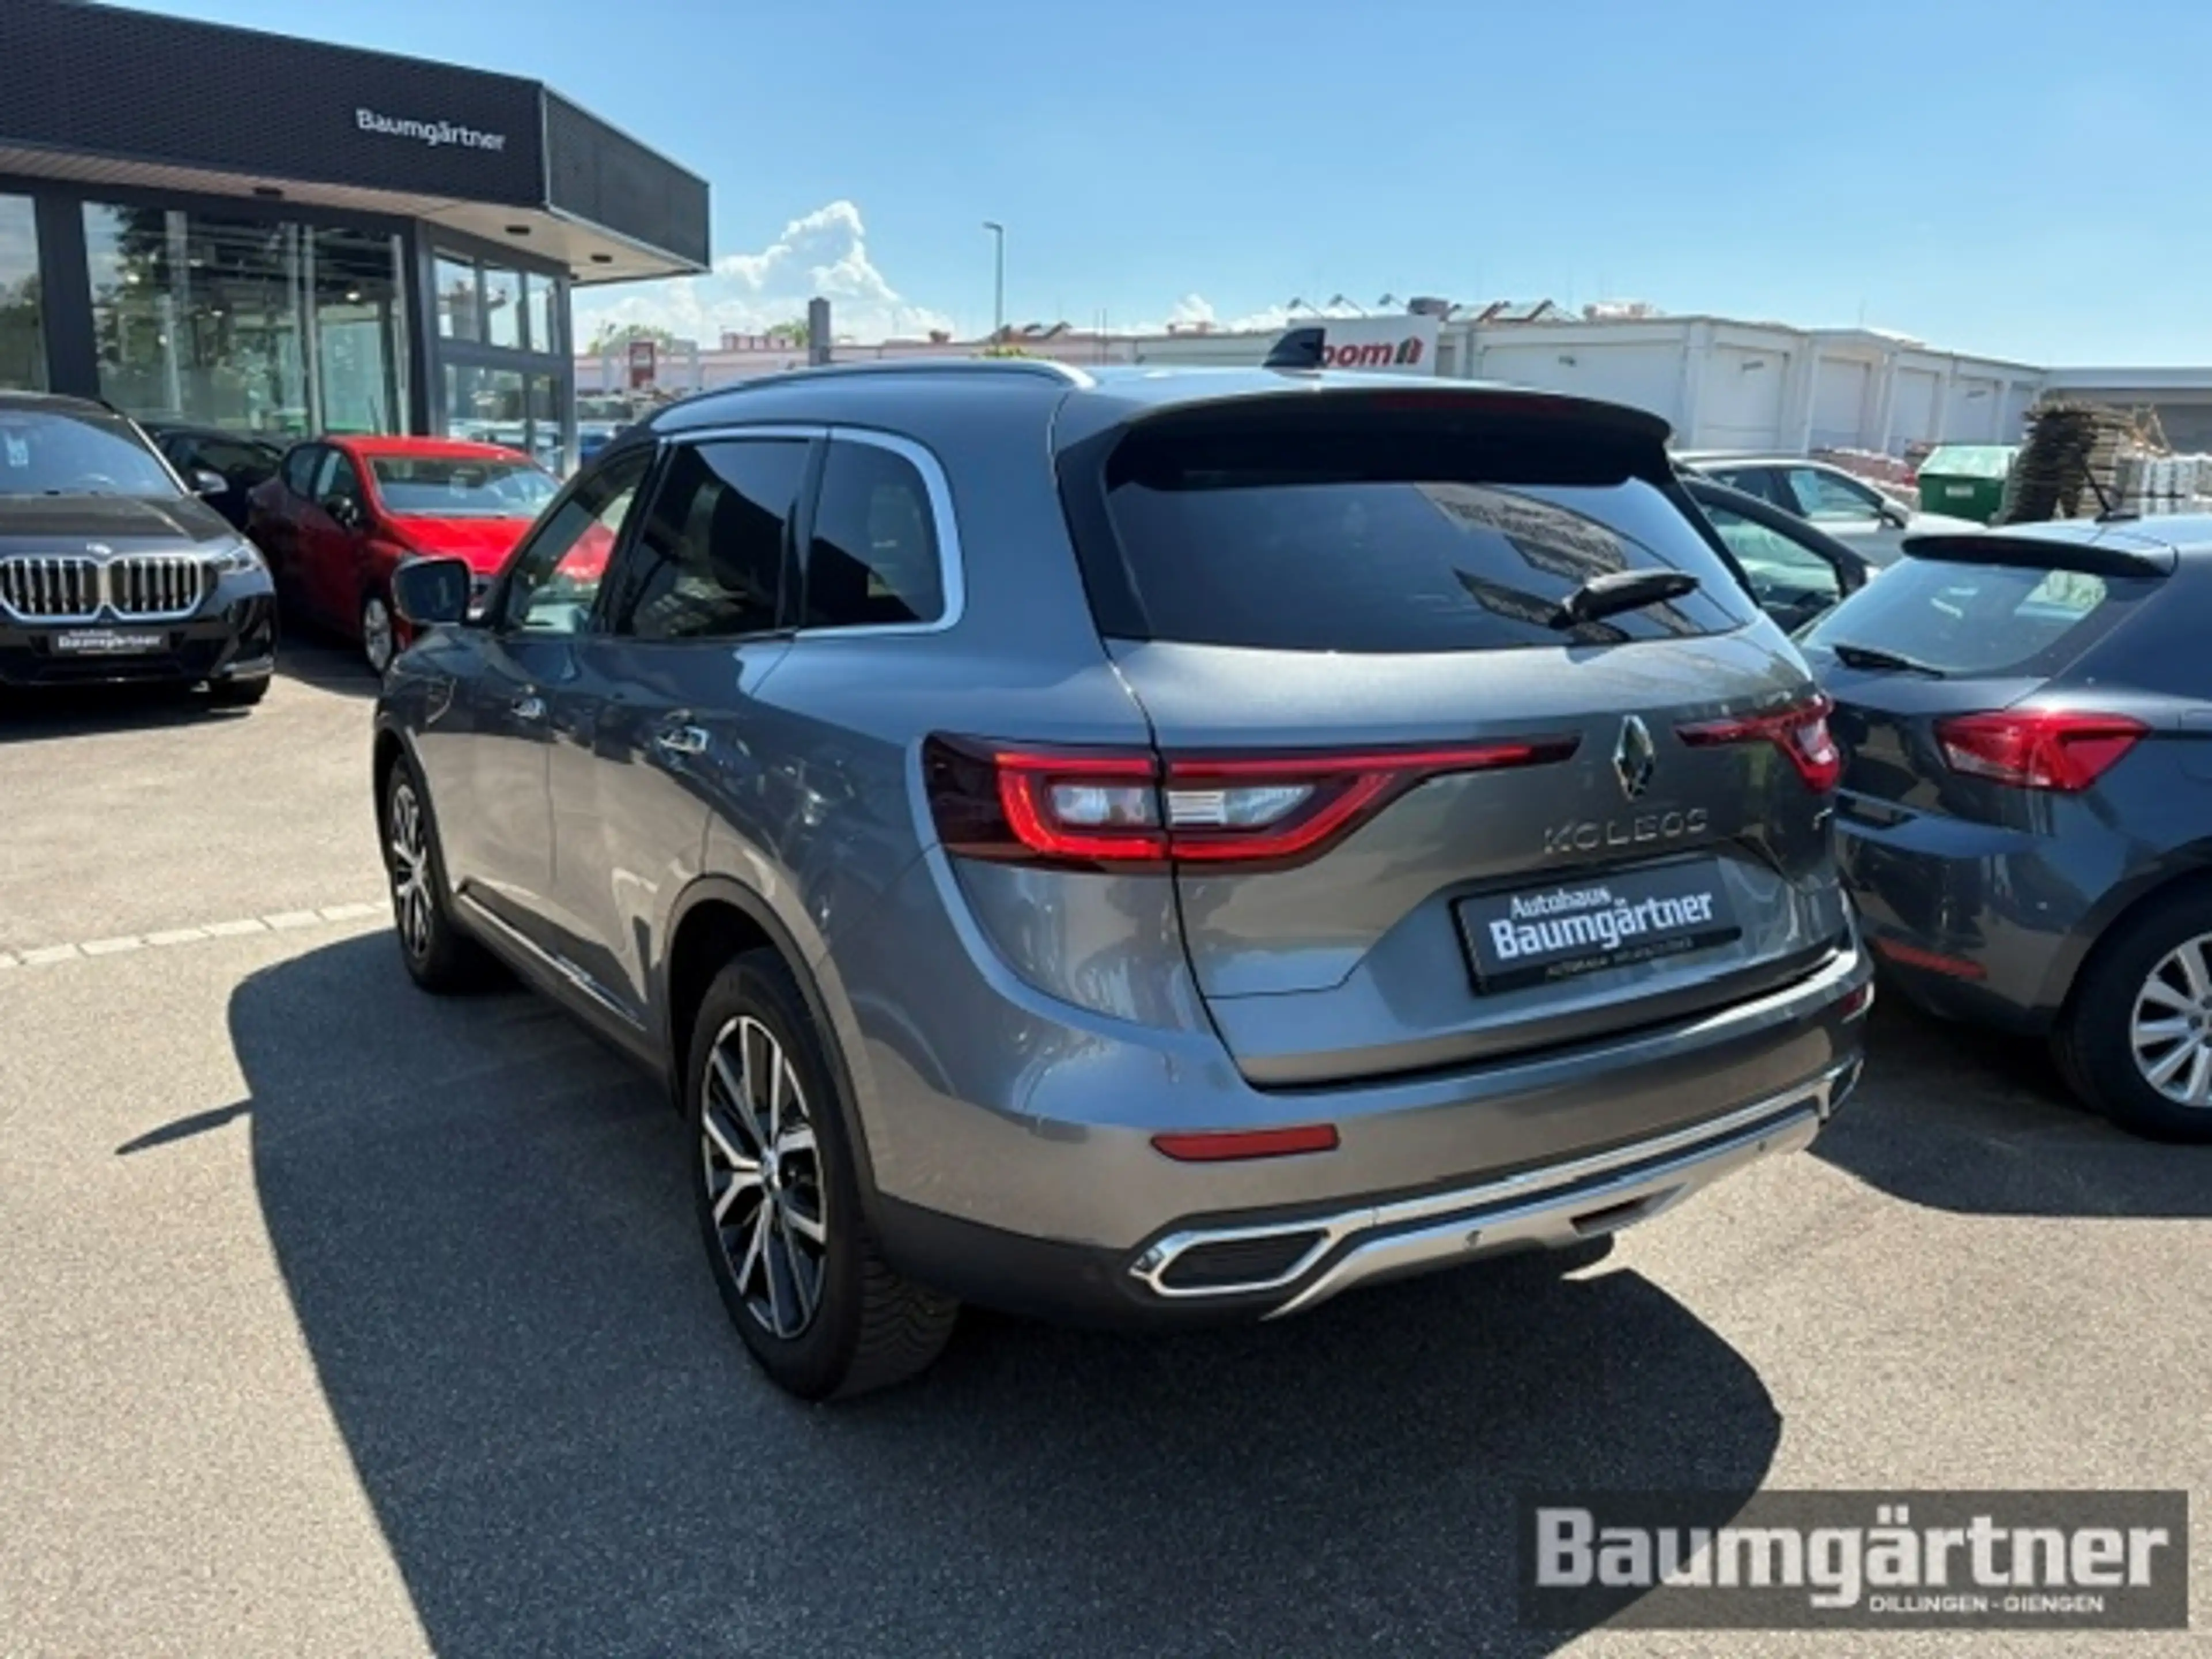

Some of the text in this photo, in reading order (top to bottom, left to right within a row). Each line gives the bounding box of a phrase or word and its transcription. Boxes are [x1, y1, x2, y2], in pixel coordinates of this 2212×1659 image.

[355, 108, 506, 151] Baumgärtner
[1324, 342, 1393, 366] oom
[1544, 807, 1709, 854] KOLEOS
[1511, 886, 1611, 919] Autohaus
[1489, 892, 1713, 959] Baumgärtner
